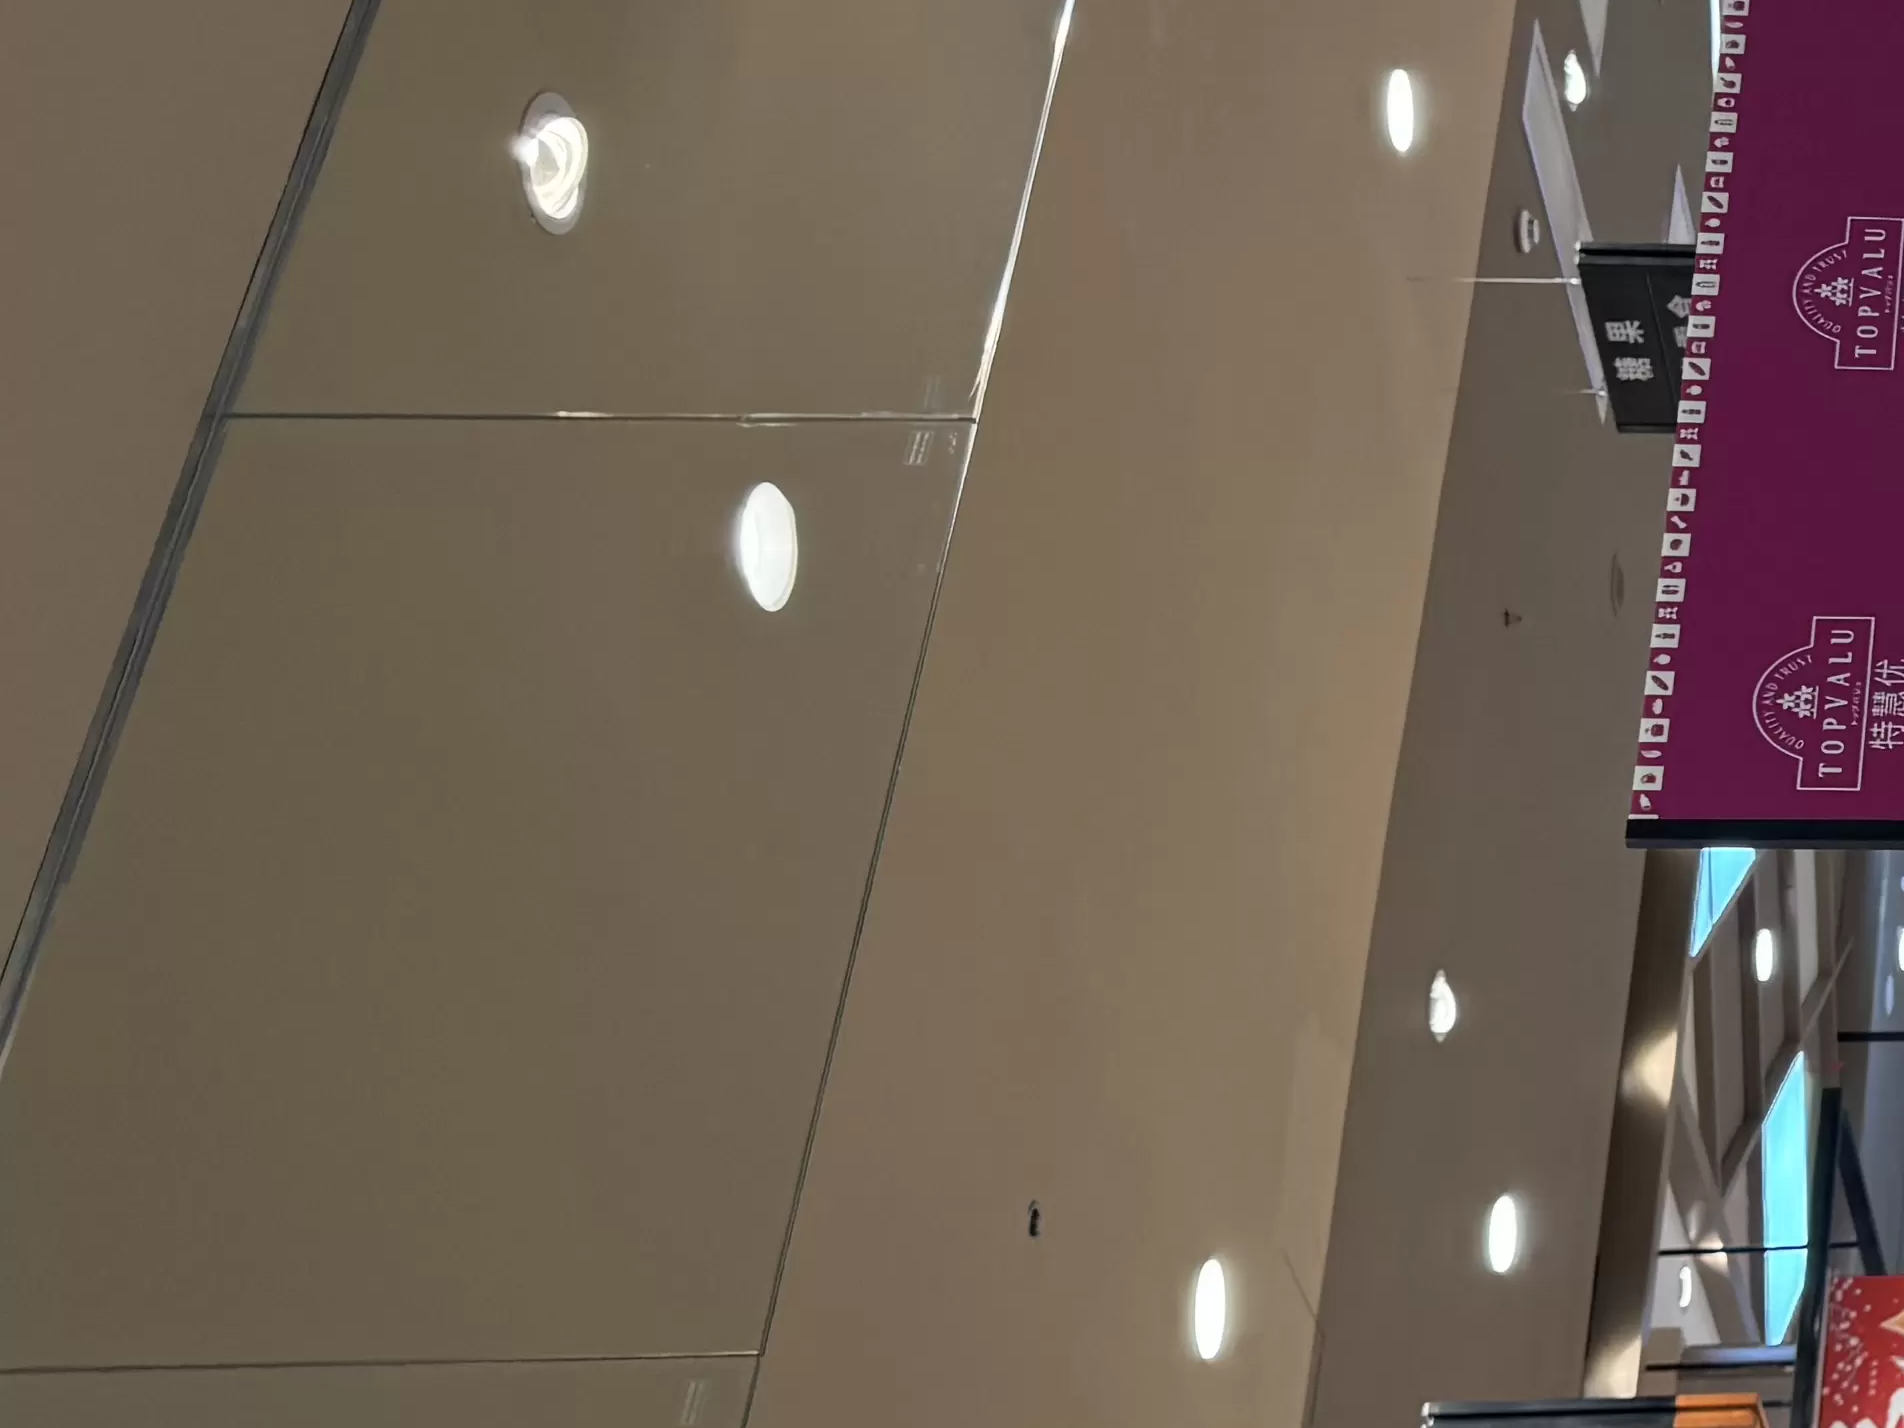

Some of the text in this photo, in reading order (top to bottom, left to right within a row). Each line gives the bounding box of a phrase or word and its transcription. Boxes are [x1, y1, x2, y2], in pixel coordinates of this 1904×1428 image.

[1800, 248, 1851, 335] QUALITY AND TRUST
[1854, 226, 1888, 359] TOPVALU
[1603, 319, 1655, 382] 糖果
[1760, 652, 1813, 751] QUALITY AND TRUST
[1817, 626, 1857, 779] TOPVALU
